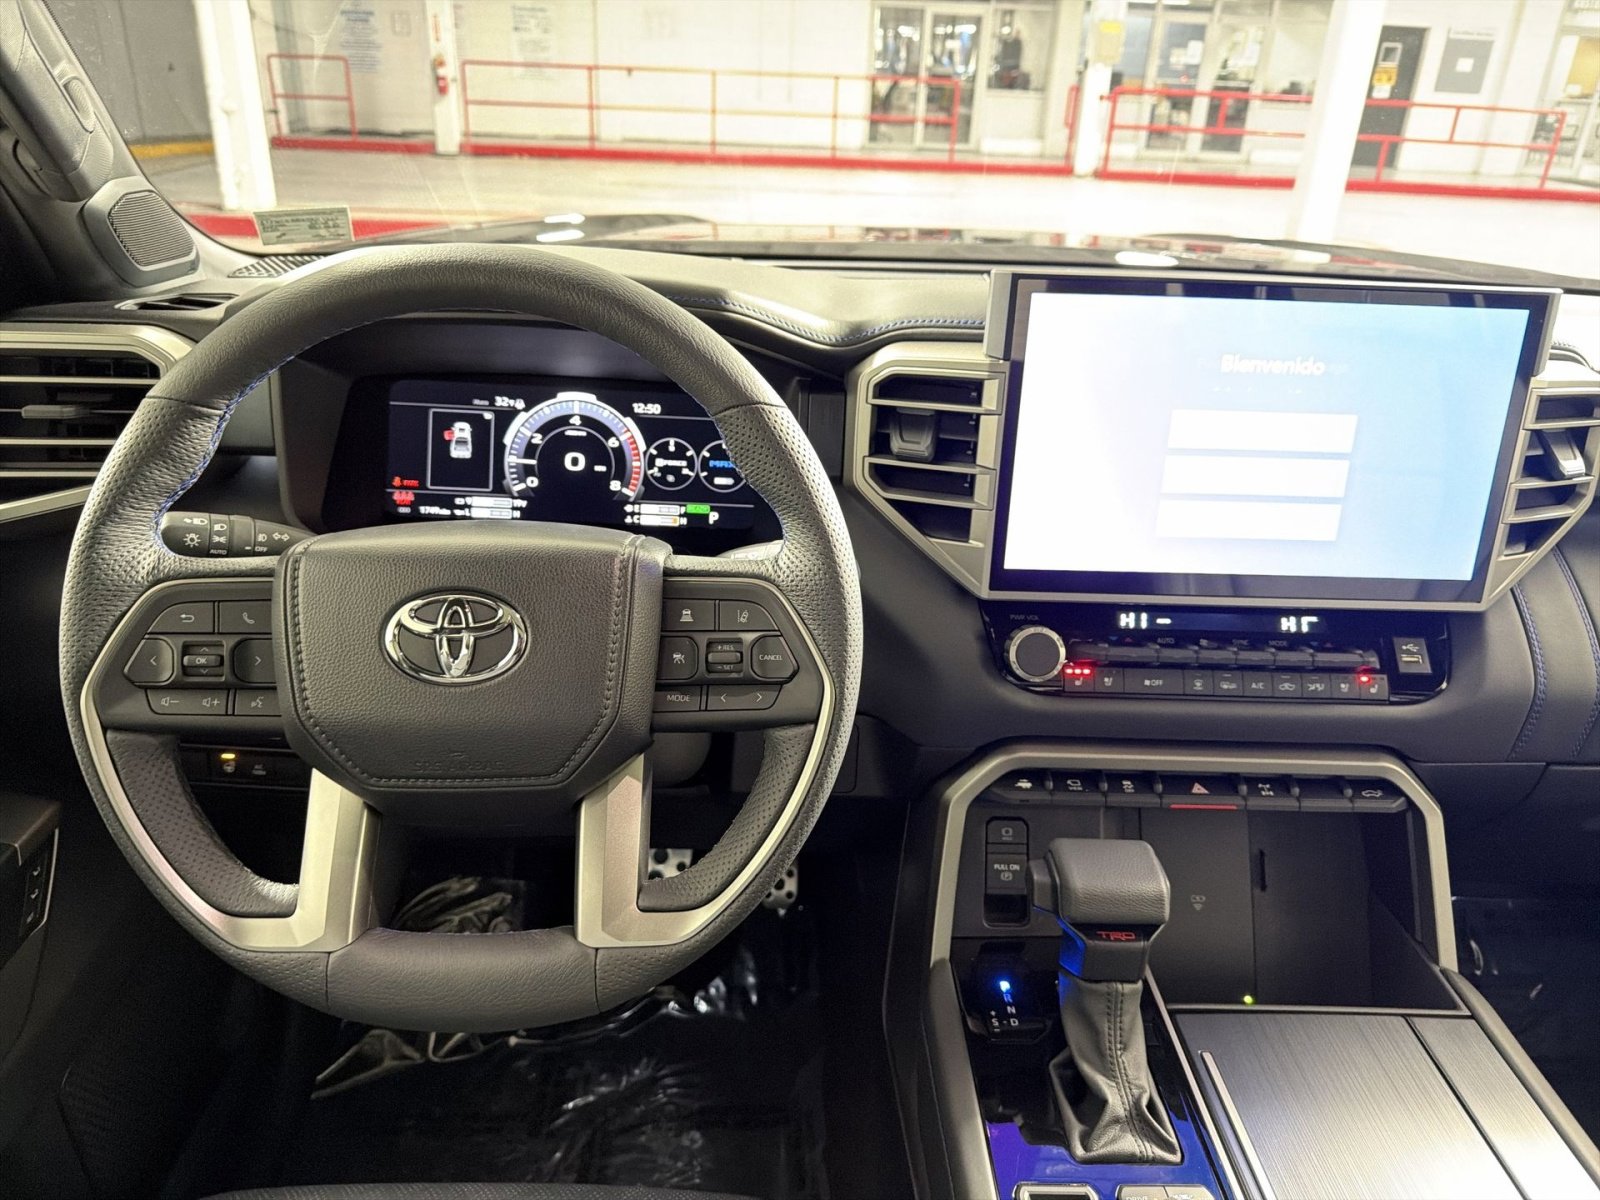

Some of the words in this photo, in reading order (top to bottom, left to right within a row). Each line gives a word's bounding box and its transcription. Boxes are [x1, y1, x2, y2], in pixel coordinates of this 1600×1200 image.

[1220, 353, 1327, 376] Bienvenido
[632, 402, 661, 414] 12:50
[569, 414, 581, 426] 4
[531, 432, 543, 444] 2
[607, 436, 620, 448] 6
[564, 451, 586, 472] 0
[526, 476, 539, 488] 0
[609, 480, 621, 491] 8
[708, 511, 720, 525] P
[195, 657, 207, 665] OK
[1150, 678, 1164, 687] OFF
[1250, 681, 1265, 690] A/C
[666, 694, 691, 702] MODE
[1096, 930, 1136, 941] TRD
